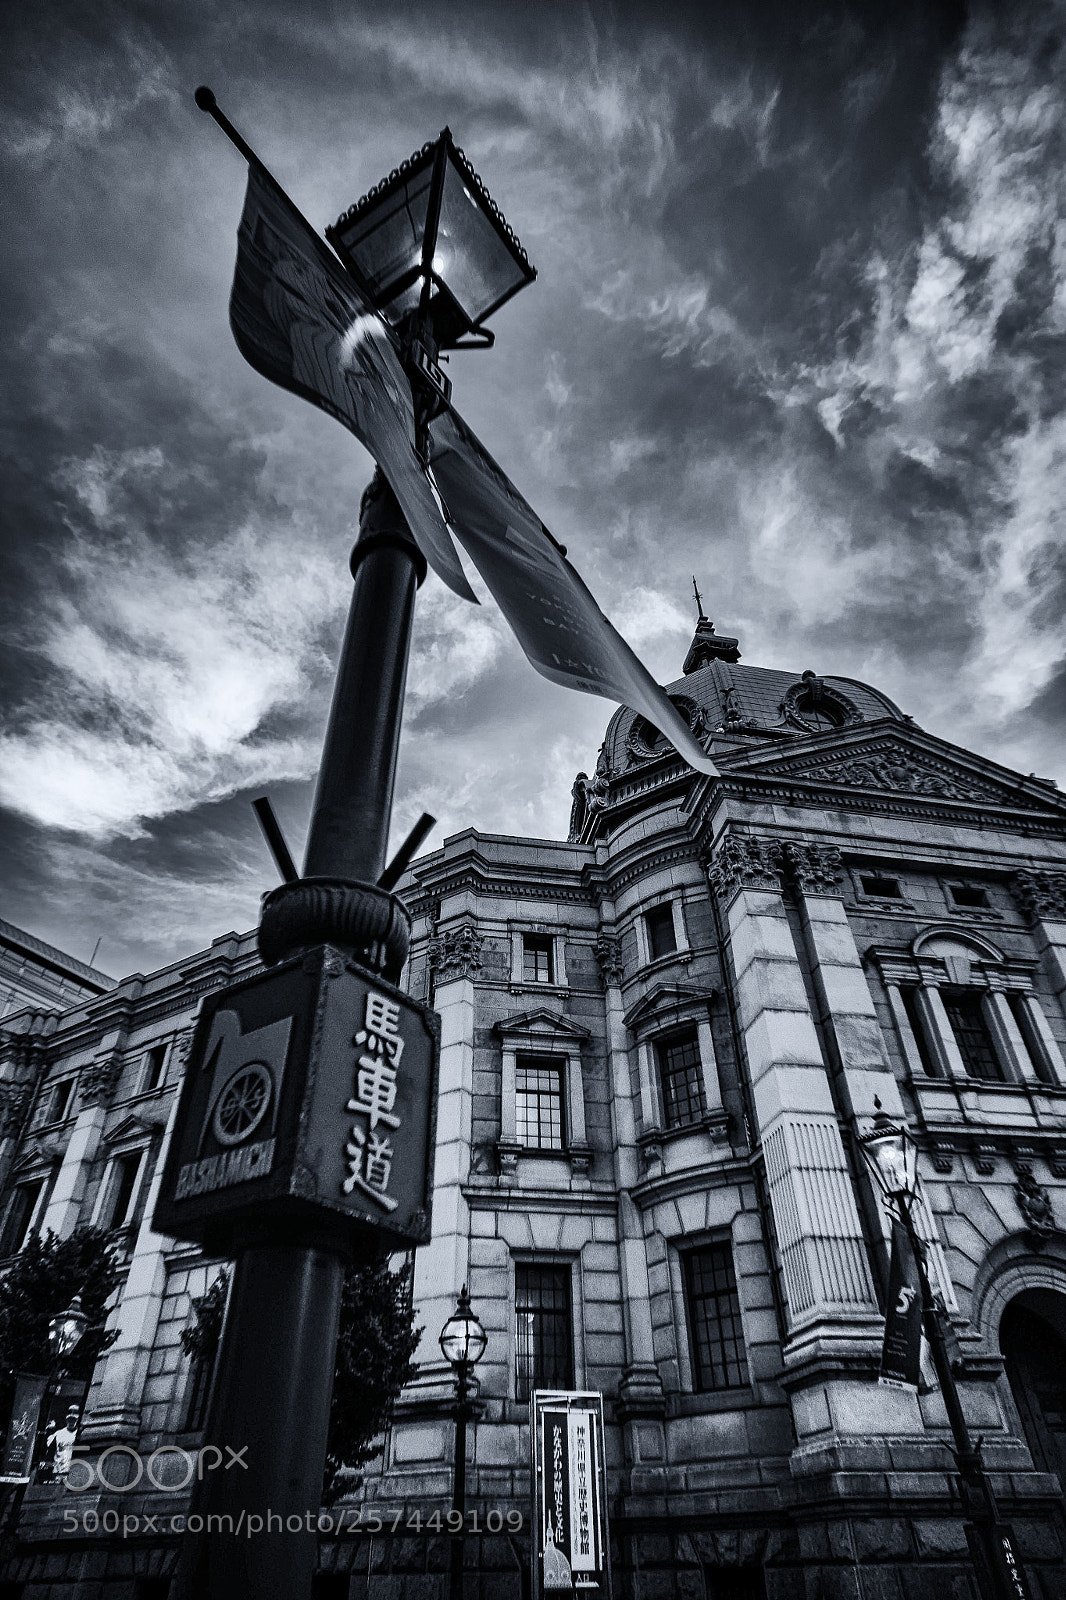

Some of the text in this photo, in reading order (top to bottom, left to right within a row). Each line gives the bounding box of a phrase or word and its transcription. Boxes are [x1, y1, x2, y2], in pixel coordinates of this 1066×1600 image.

[343, 992, 405, 1211] 馬車道
[174, 1138, 277, 1200] BASHAMICHI
[553, 1424, 565, 1543] かながわの歴史と文化
[577, 1425, 590, 1555] 神奈川県立歴史博物館
